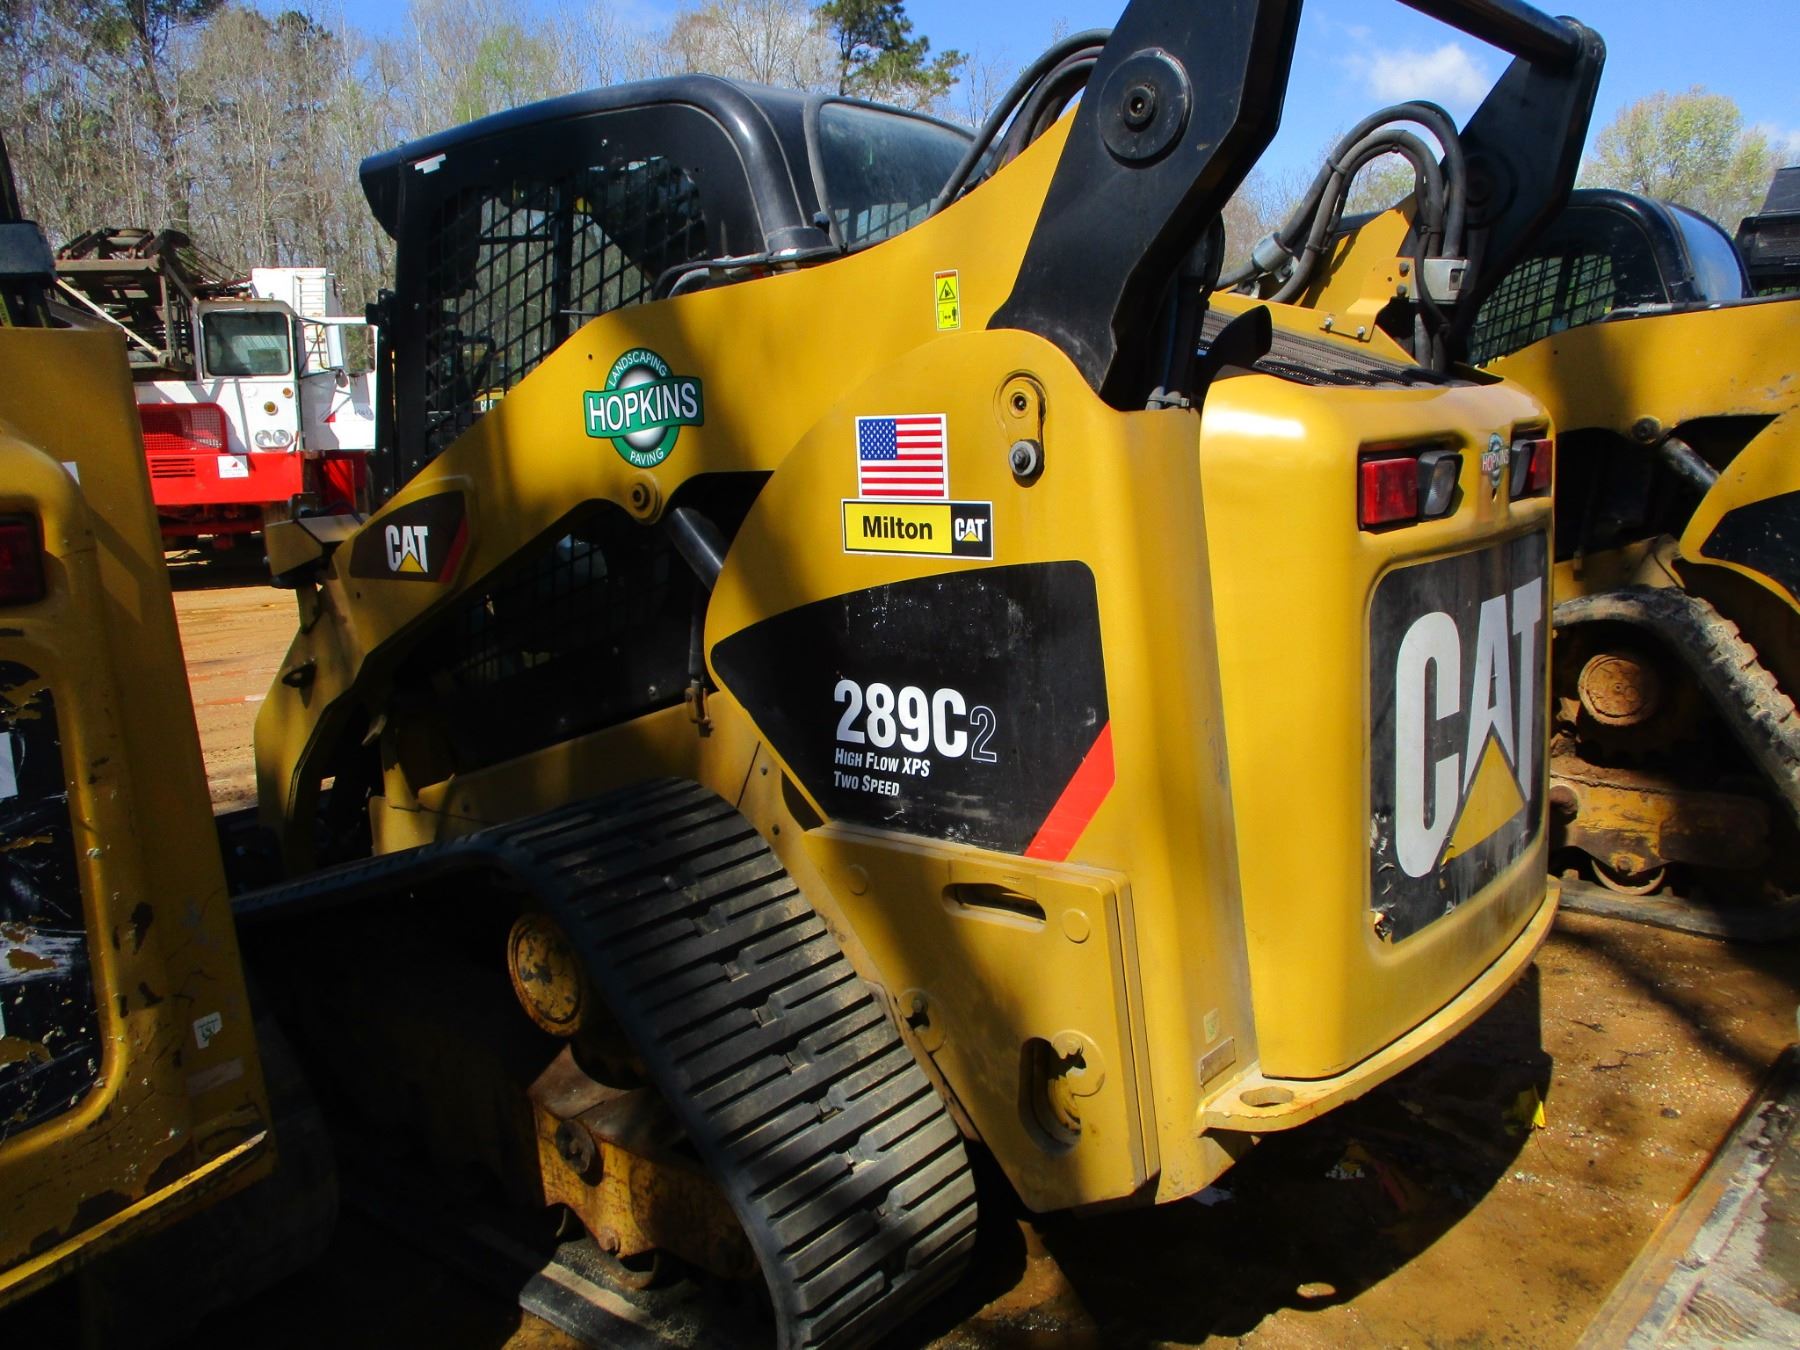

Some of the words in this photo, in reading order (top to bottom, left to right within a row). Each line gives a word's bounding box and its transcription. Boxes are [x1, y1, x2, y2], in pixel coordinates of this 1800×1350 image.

[608, 351, 668, 387] LANDSCAPING
[589, 382, 698, 431] HOPKINS
[629, 448, 664, 466] PAVING
[862, 515, 933, 540] Milton
[954, 517, 987, 543] CAT
[385, 524, 429, 573] CAT
[1395, 576, 1542, 878] CAT
[834, 748, 863, 768] HIGH
[865, 752, 900, 773] FLOW
[902, 756, 931, 778] XPS
[833, 771, 859, 790] TWO
[861, 774, 900, 797] SPEED
